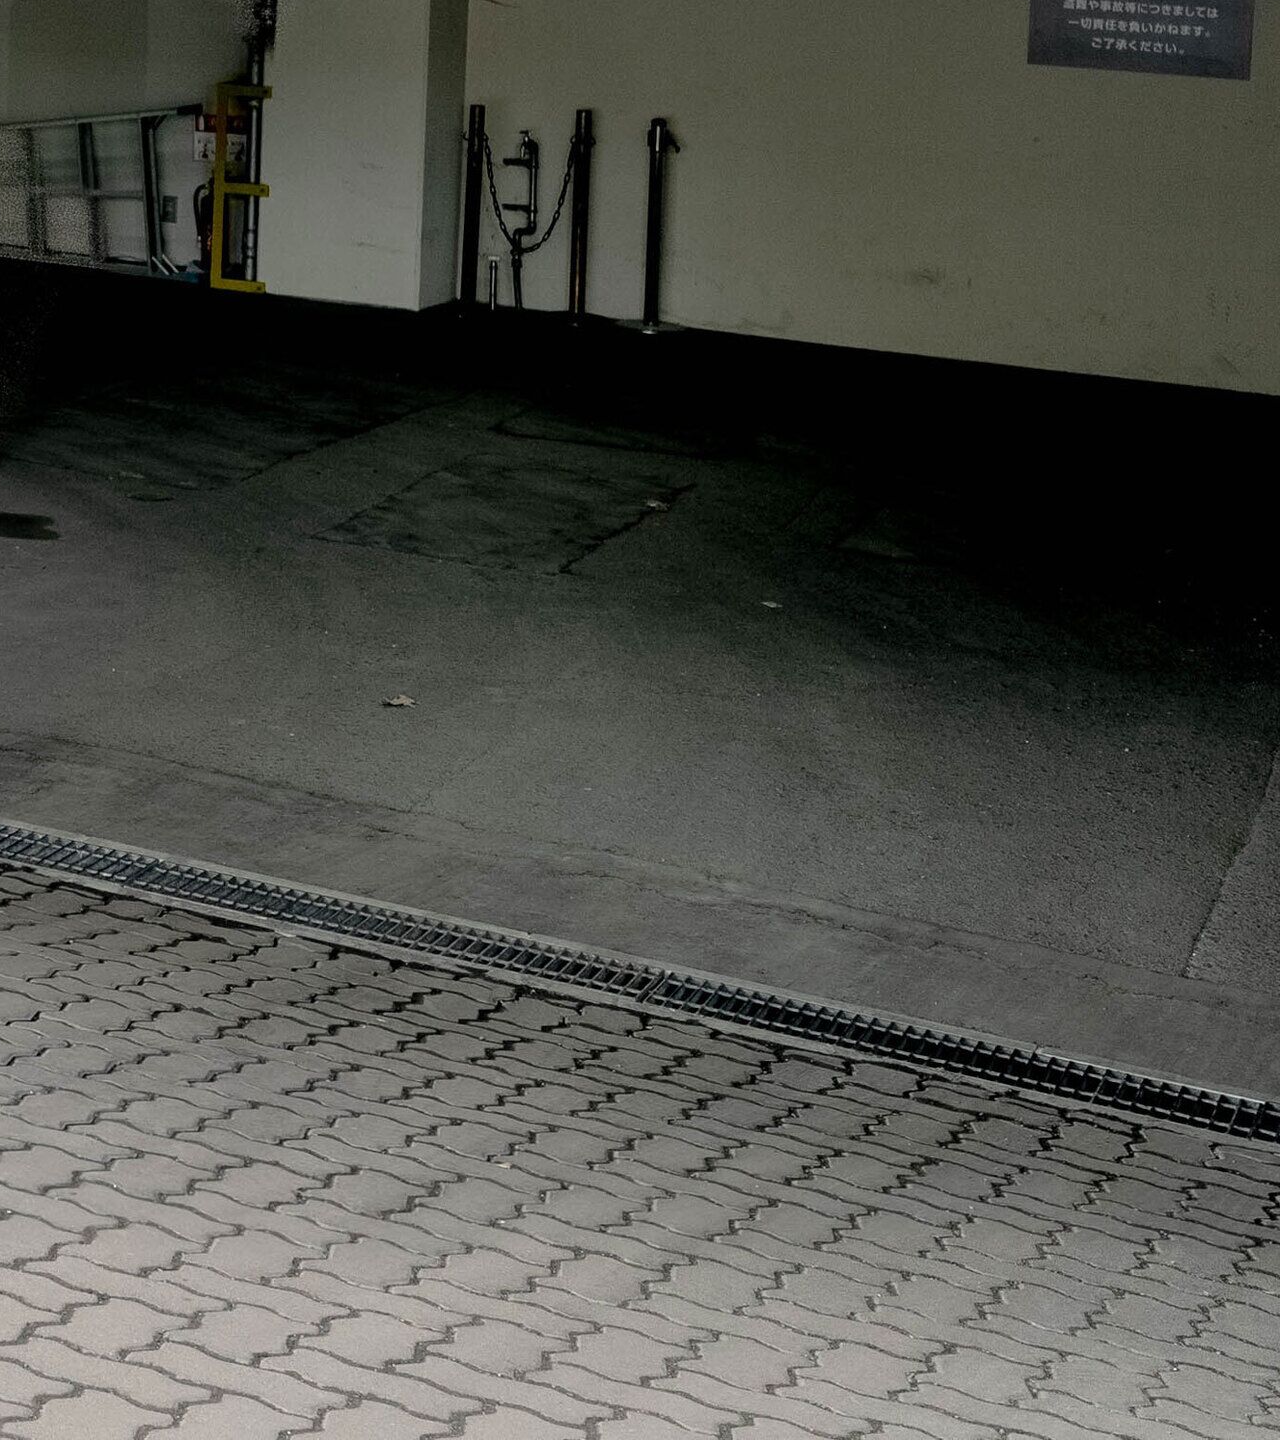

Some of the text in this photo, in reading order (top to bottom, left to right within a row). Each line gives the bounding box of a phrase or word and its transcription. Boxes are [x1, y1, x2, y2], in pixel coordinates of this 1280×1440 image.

[1091, 38, 1186, 55] ご了承ください。
